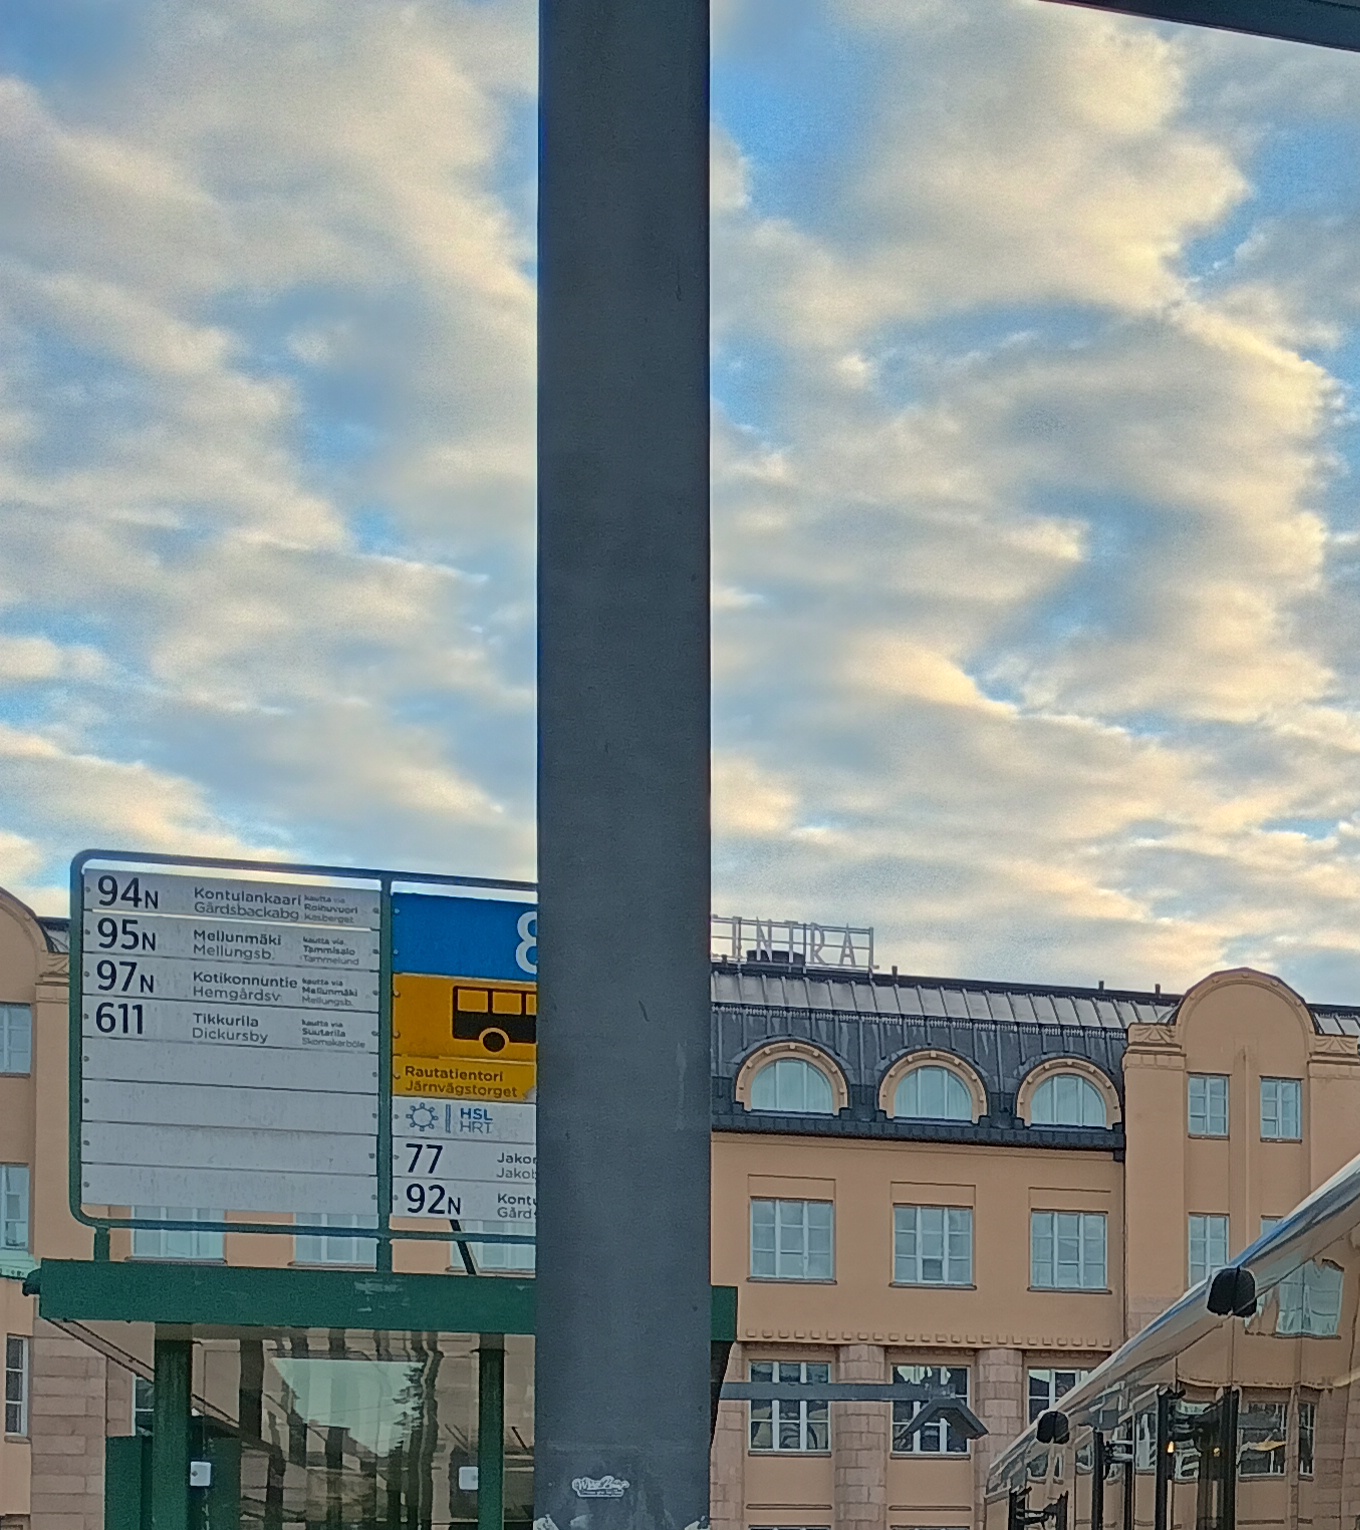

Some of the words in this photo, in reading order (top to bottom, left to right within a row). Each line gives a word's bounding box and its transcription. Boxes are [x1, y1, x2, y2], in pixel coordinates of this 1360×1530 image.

[97, 874, 159, 910] 94N
[194, 886, 301, 906] Kontulankaari
[97, 917, 157, 952] 95N
[193, 929, 282, 946] Mellunmäki
[711, 914, 879, 968] ENTRAL
[96, 959, 155, 994] 97N
[193, 971, 298, 989] Kotikonnuntie
[95, 1002, 144, 1035] 611
[192, 1012, 260, 1028] Tikkurila
[192, 1027, 269, 1044] Dickursby
[405, 1065, 504, 1082] Rautatientori
[405, 1081, 518, 1098] Järnvägstorget
[460, 1107, 494, 1121] HSL
[459, 1120, 494, 1134] HRT
[405, 1142, 444, 1174] 77
[406, 1183, 461, 1215] 92N
[497, 1206, 537, 1220] Gård
